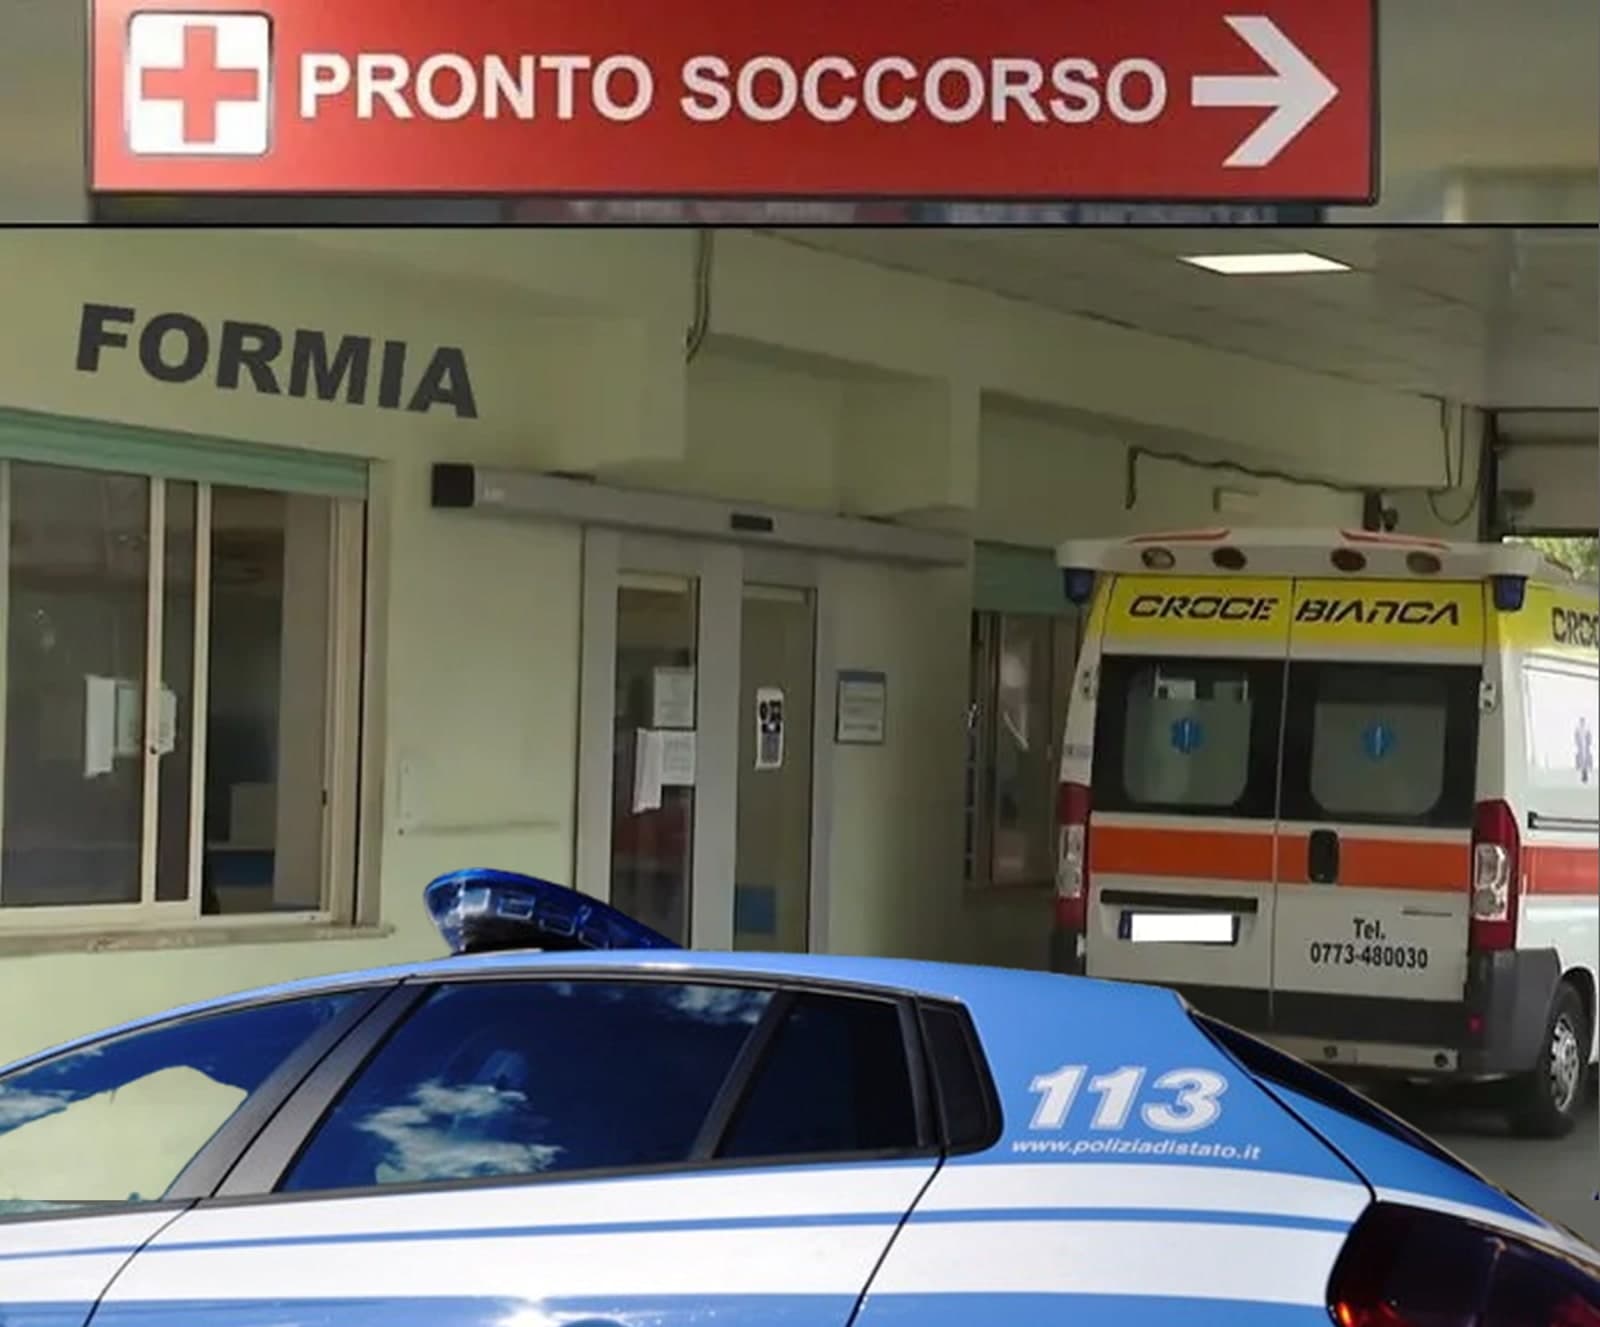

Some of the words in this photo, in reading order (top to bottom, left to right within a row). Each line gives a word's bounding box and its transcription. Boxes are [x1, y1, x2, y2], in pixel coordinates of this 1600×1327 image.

[299, 53, 654, 121] PRONTO
[680, 56, 1167, 125] SOCCORSO
[76, 303, 478, 419] FORMIA
[1128, 595, 1279, 622] CROCE
[1295, 598, 1460, 627] BIANCA
[1353, 917, 1387, 940] Tel.
[1310, 942, 1429, 969] 0773-480030
[1028, 1065, 1228, 1133] 113
[1012, 1137, 1262, 1161] www.poliziadistato.it
